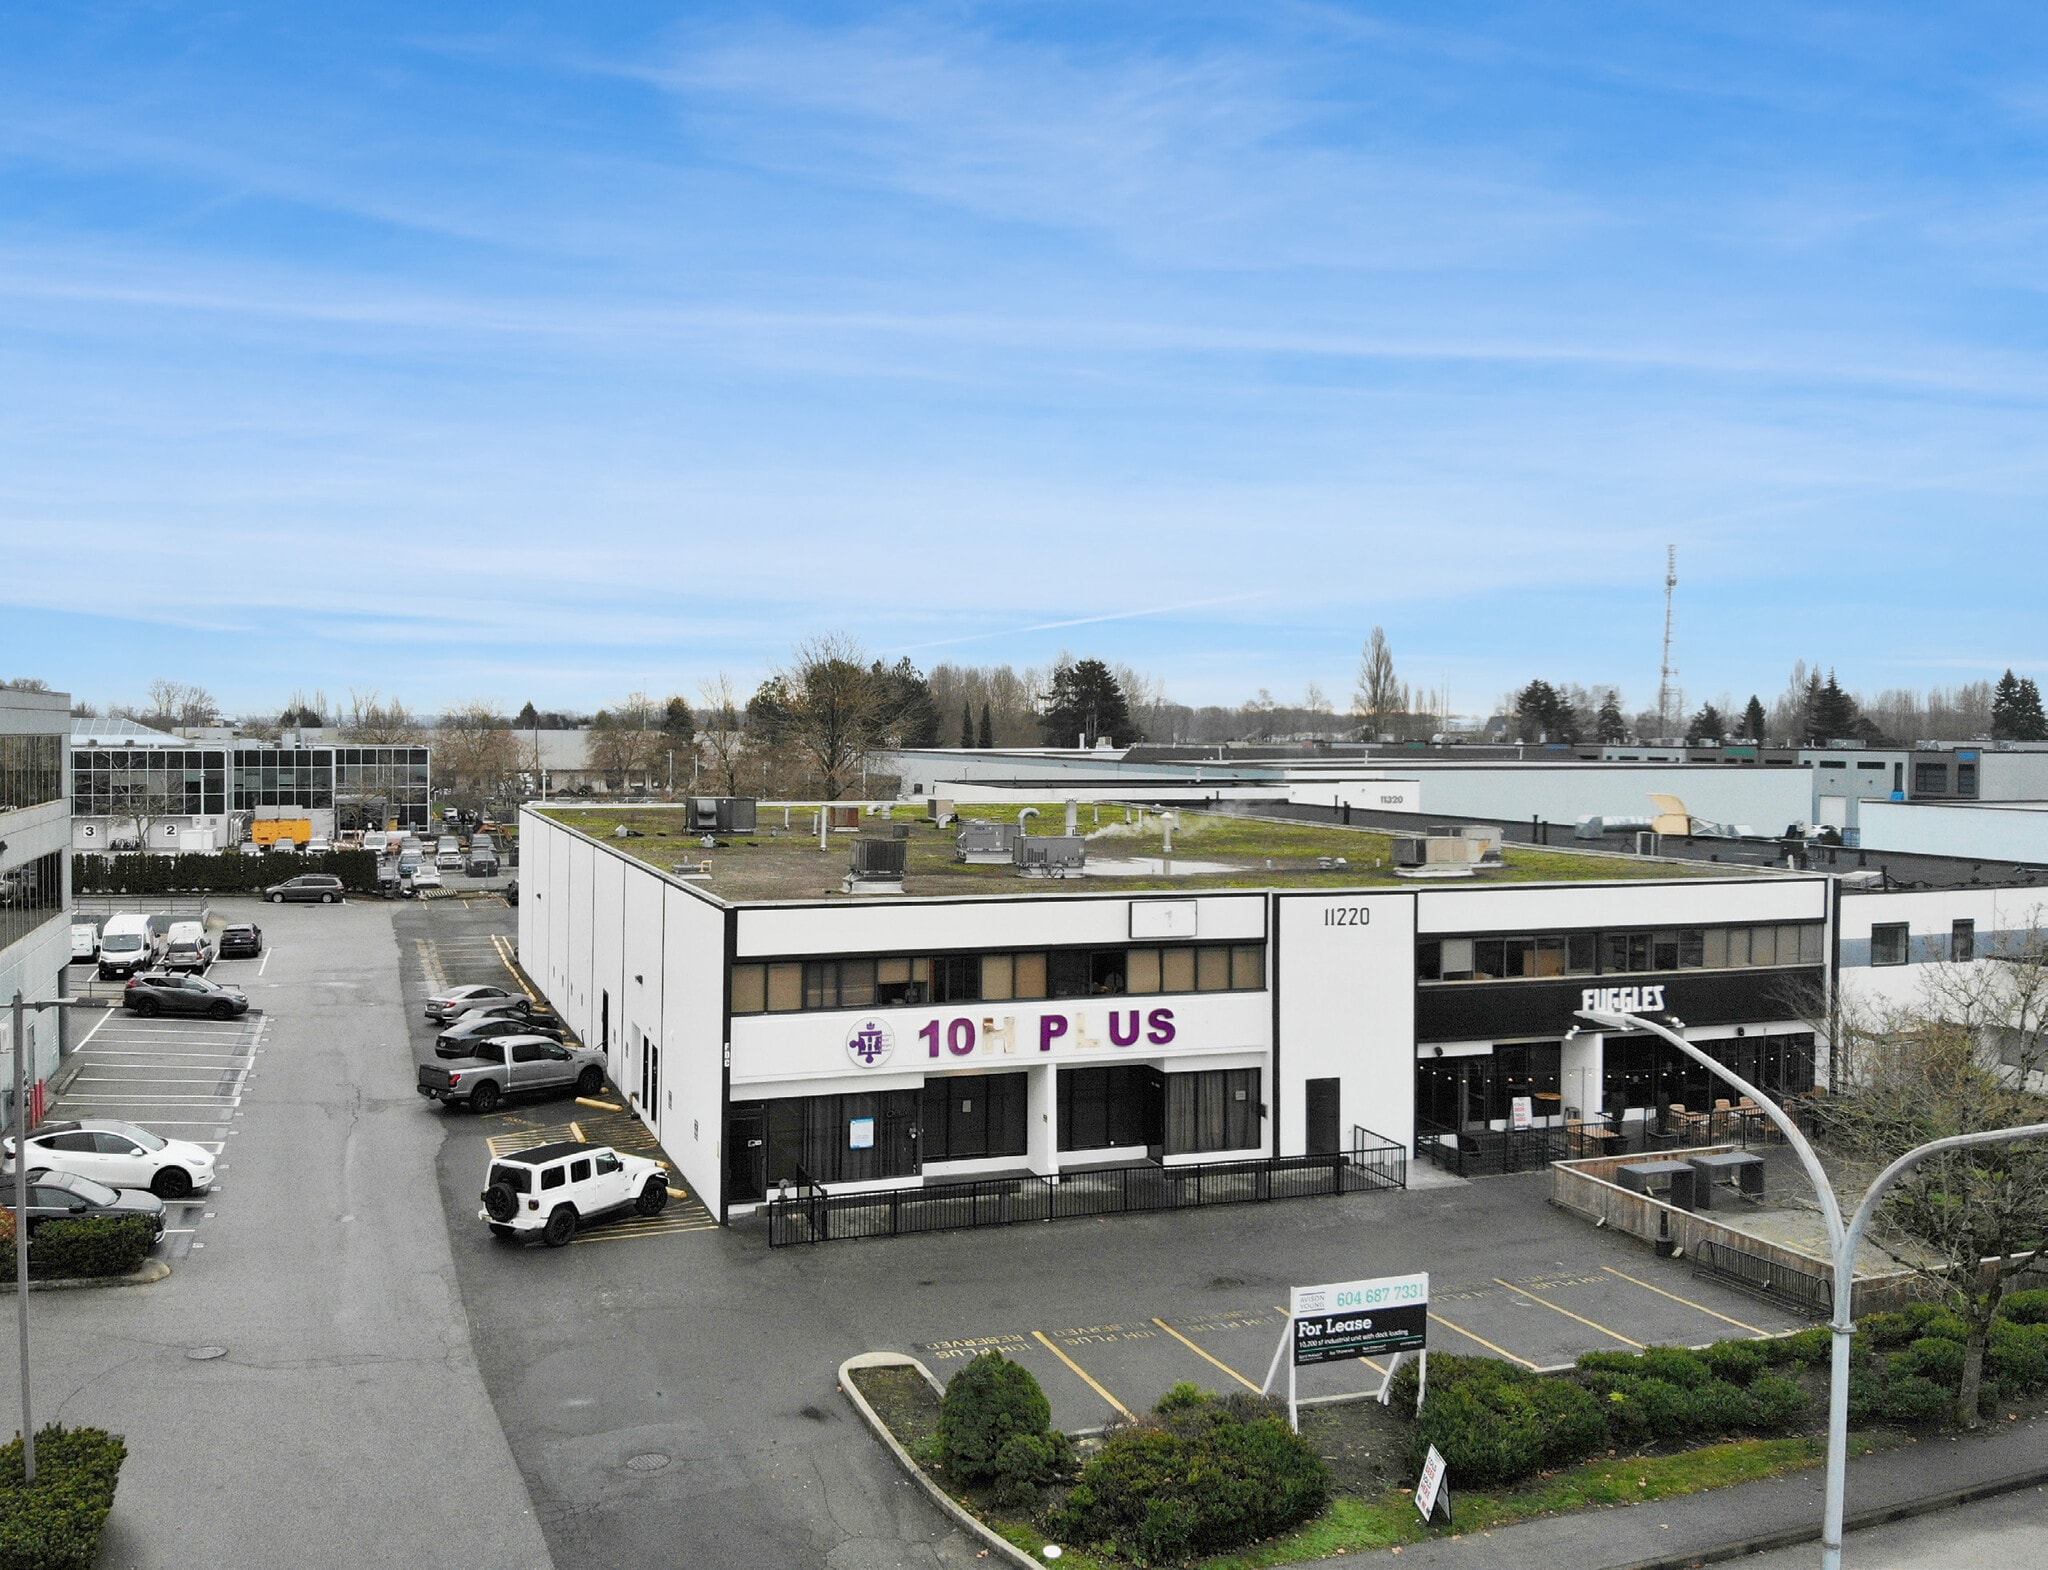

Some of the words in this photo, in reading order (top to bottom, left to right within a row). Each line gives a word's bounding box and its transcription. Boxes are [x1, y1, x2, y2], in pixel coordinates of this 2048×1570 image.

[1380, 795, 1403, 804] 11320
[85, 827, 94, 836] 3
[166, 826, 175, 835] 2
[1325, 907, 1370, 926] 11220
[1582, 985, 1665, 1012] FUGGLES
[918, 1016, 1016, 1058] 10H
[1039, 1008, 1176, 1052] PLUS
[1300, 1295, 1325, 1303] AVISON
[1337, 1291, 1362, 1307] 604
[1366, 1288, 1390, 1303] 687
[1394, 1283, 1424, 1300] 7331
[1300, 1302, 1325, 1310] YOUNG
[1298, 1320, 1323, 1338] For
[1326, 1318, 1372, 1334] Lease
[926, 1334, 1025, 1351] RESERVED
[1063, 1334, 1119, 1346] PLUS
[1362, 1333, 1375, 1342] with
[935, 1347, 991, 1359] PLUS
